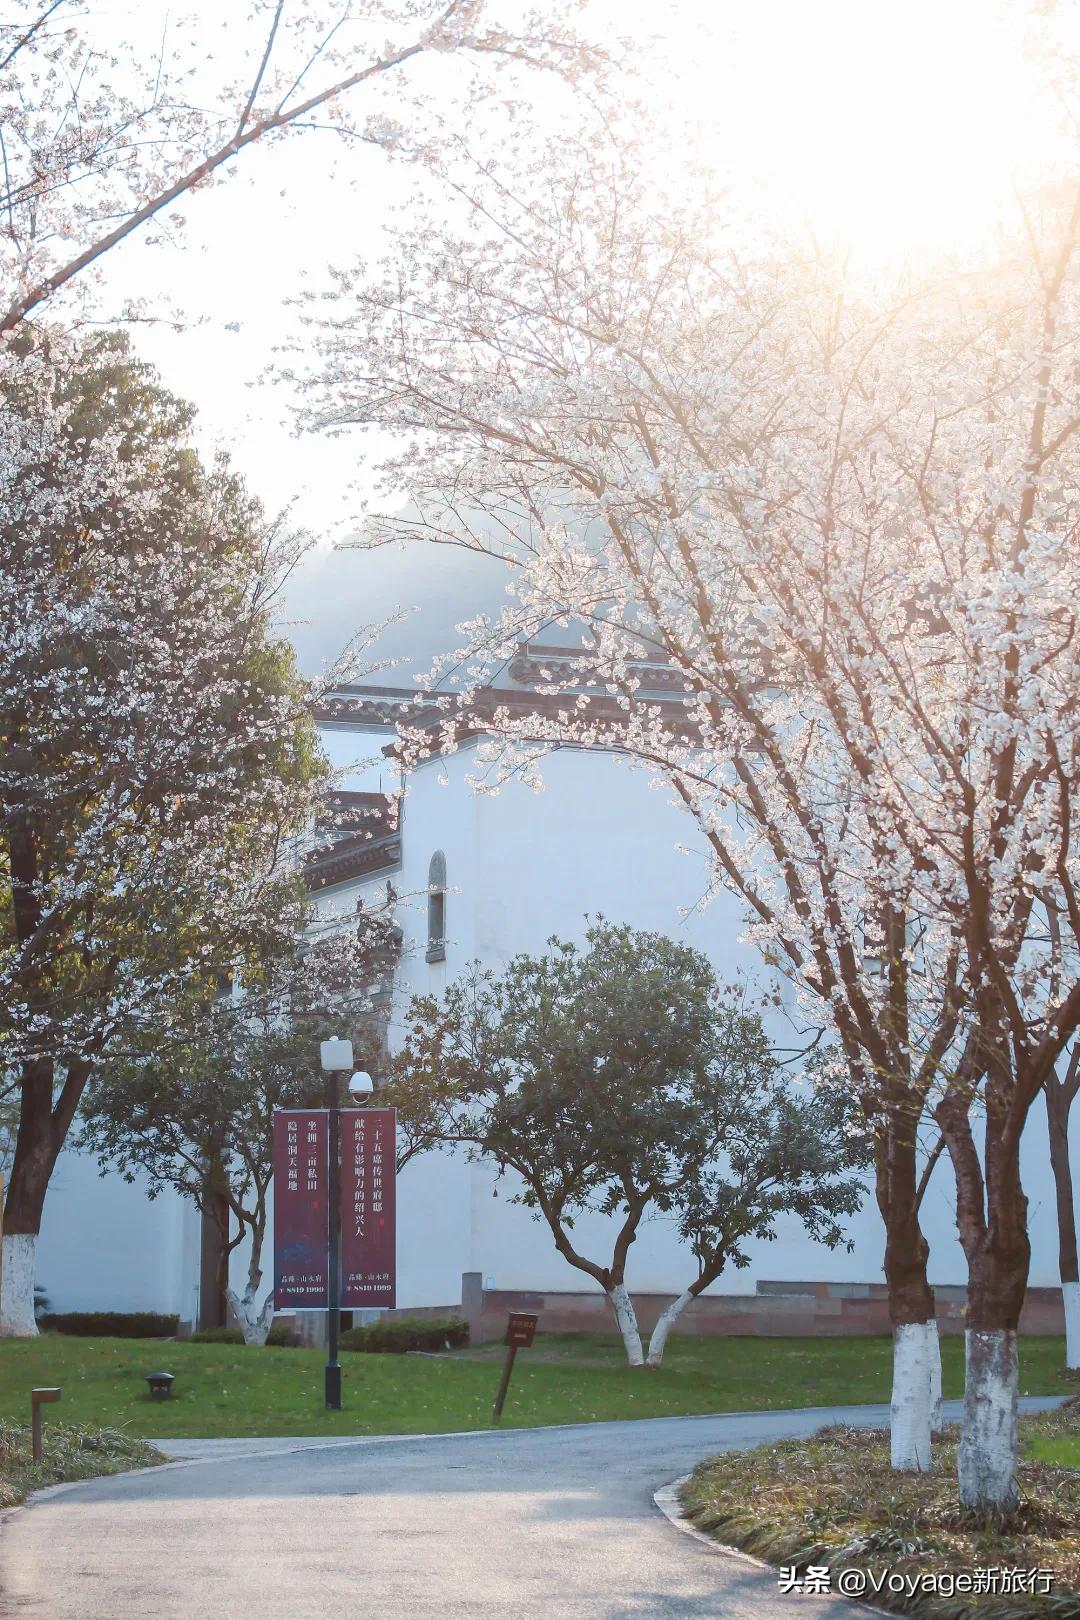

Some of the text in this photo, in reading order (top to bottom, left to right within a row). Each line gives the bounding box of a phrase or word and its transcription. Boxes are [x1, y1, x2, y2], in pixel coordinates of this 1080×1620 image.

[287, 1120, 298, 1191] 隐居洞天福地
[354, 1118, 365, 1237] 献给有影响力的绍兴人
